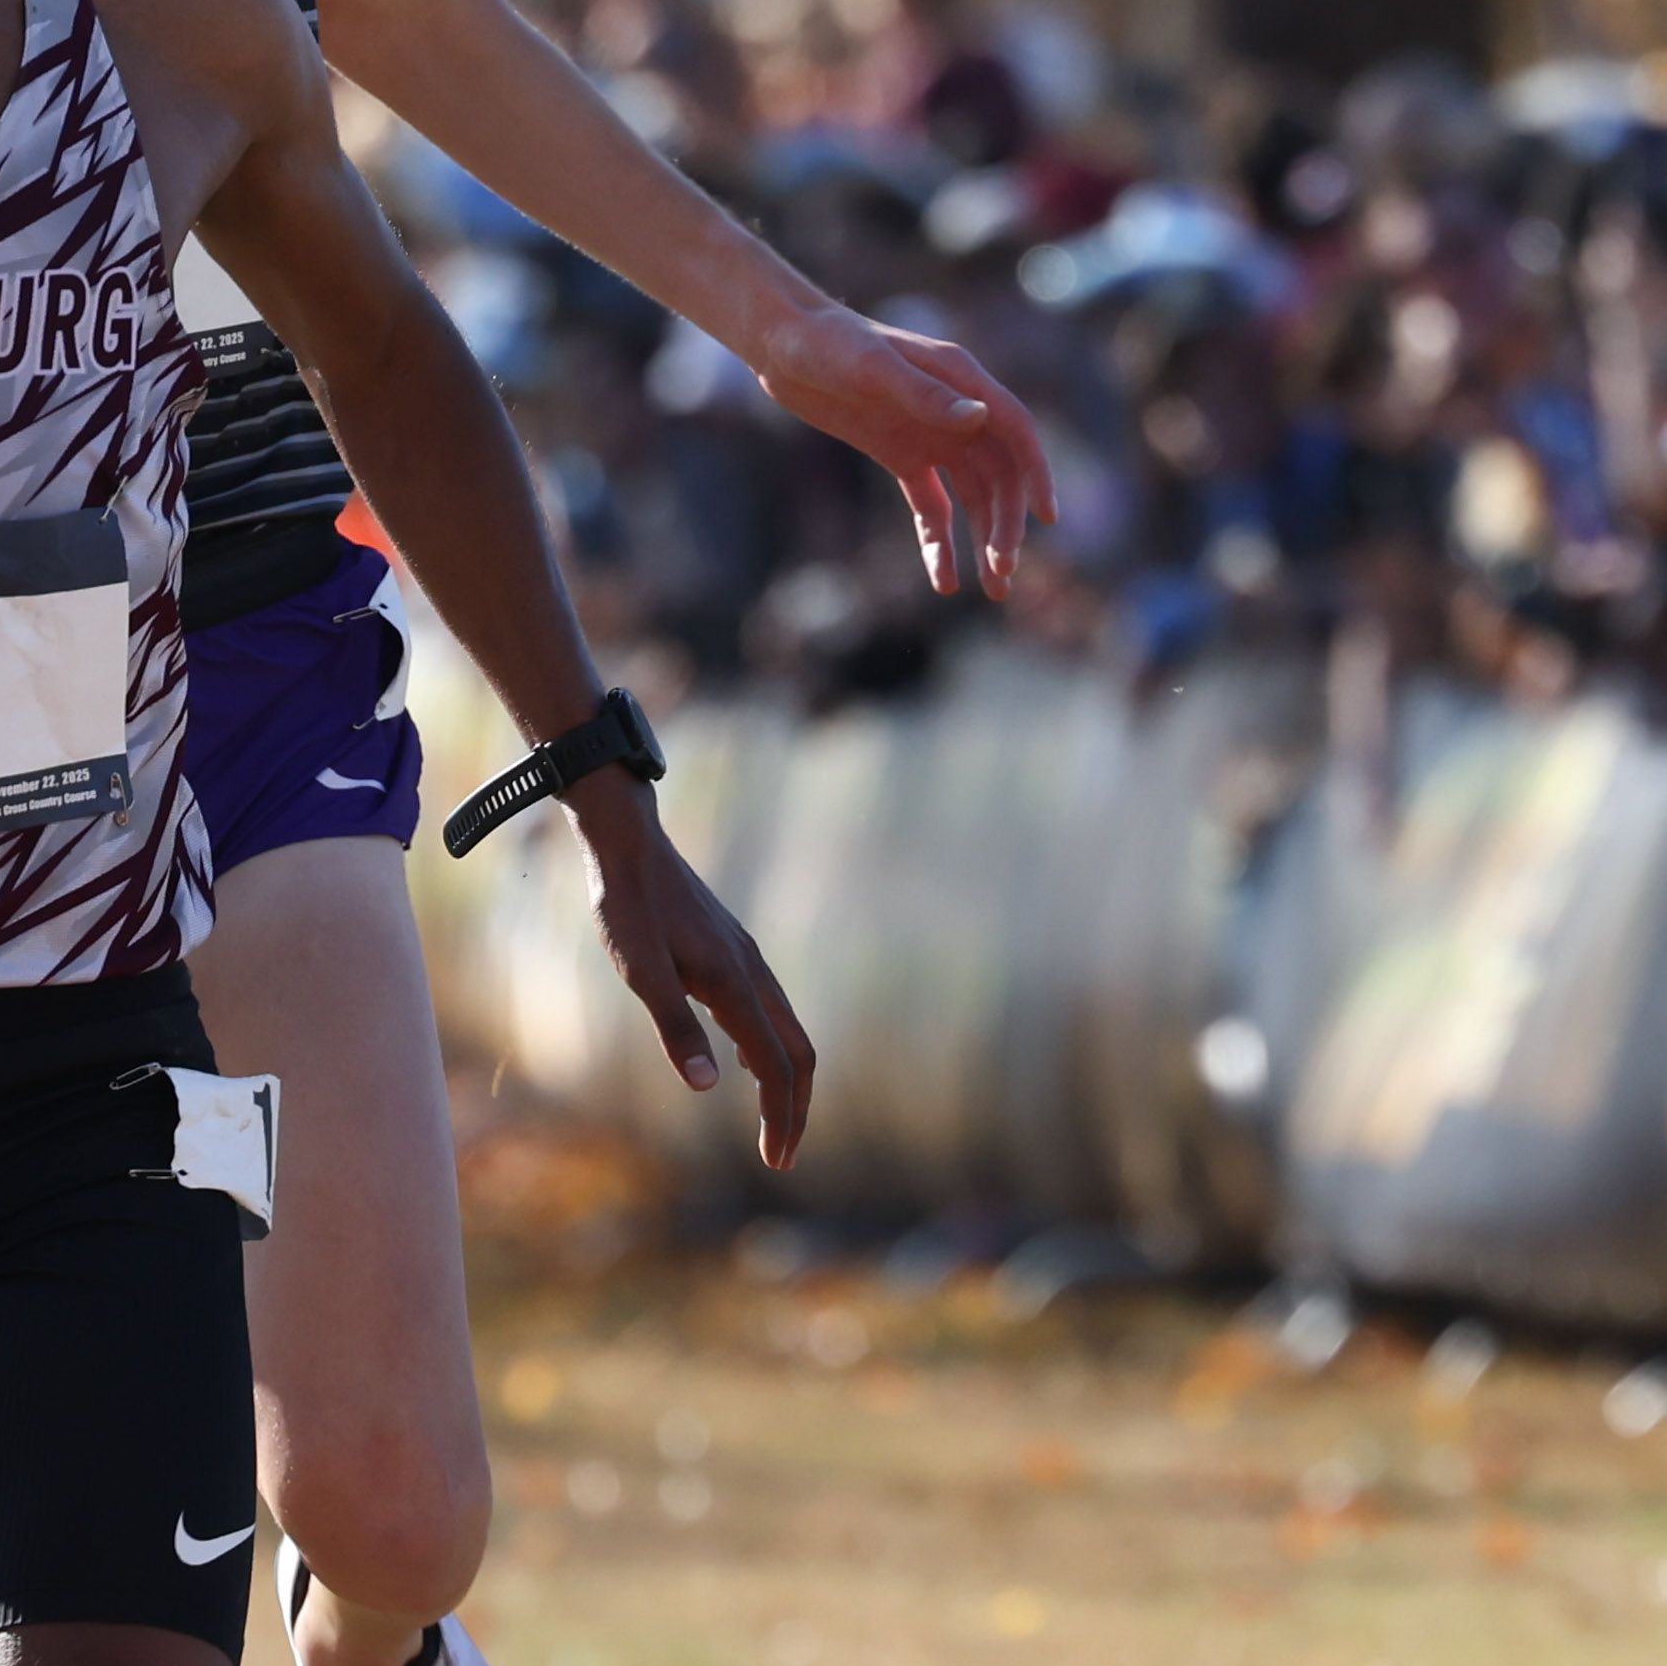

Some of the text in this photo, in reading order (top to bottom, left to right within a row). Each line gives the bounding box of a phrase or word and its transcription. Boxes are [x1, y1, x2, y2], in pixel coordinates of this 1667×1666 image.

[220, 332, 244, 346] 2025
[220, 352, 246, 364] Course
[42, 775, 59, 788] 22,
[62, 768, 90, 783] 2025
[4, 803, 27, 815] Cross
[30, 797, 62, 811] Country
[65, 790, 97, 804] Course
